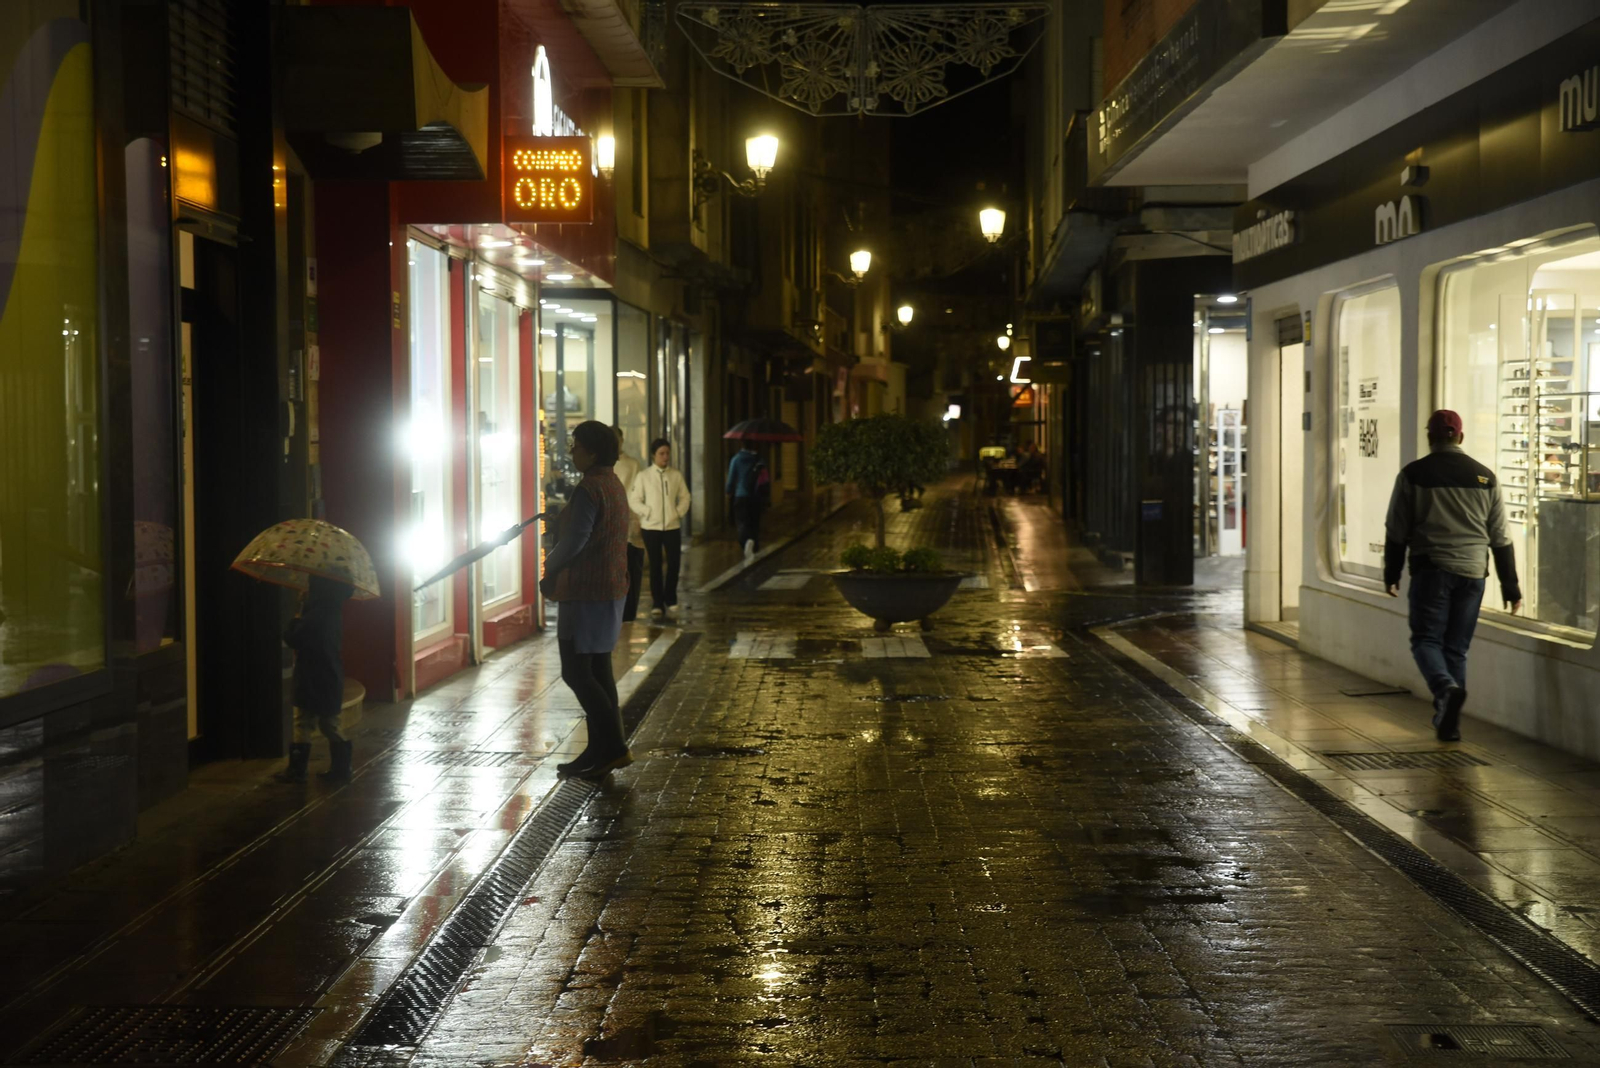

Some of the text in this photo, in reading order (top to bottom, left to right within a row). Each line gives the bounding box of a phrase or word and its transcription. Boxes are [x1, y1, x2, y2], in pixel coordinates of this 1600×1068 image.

[513, 150, 582, 171] COMPRO
[514, 176, 582, 209] ORO
[1359, 418, 1378, 438] BLACK
[1359, 438, 1379, 458] FRIDAY
